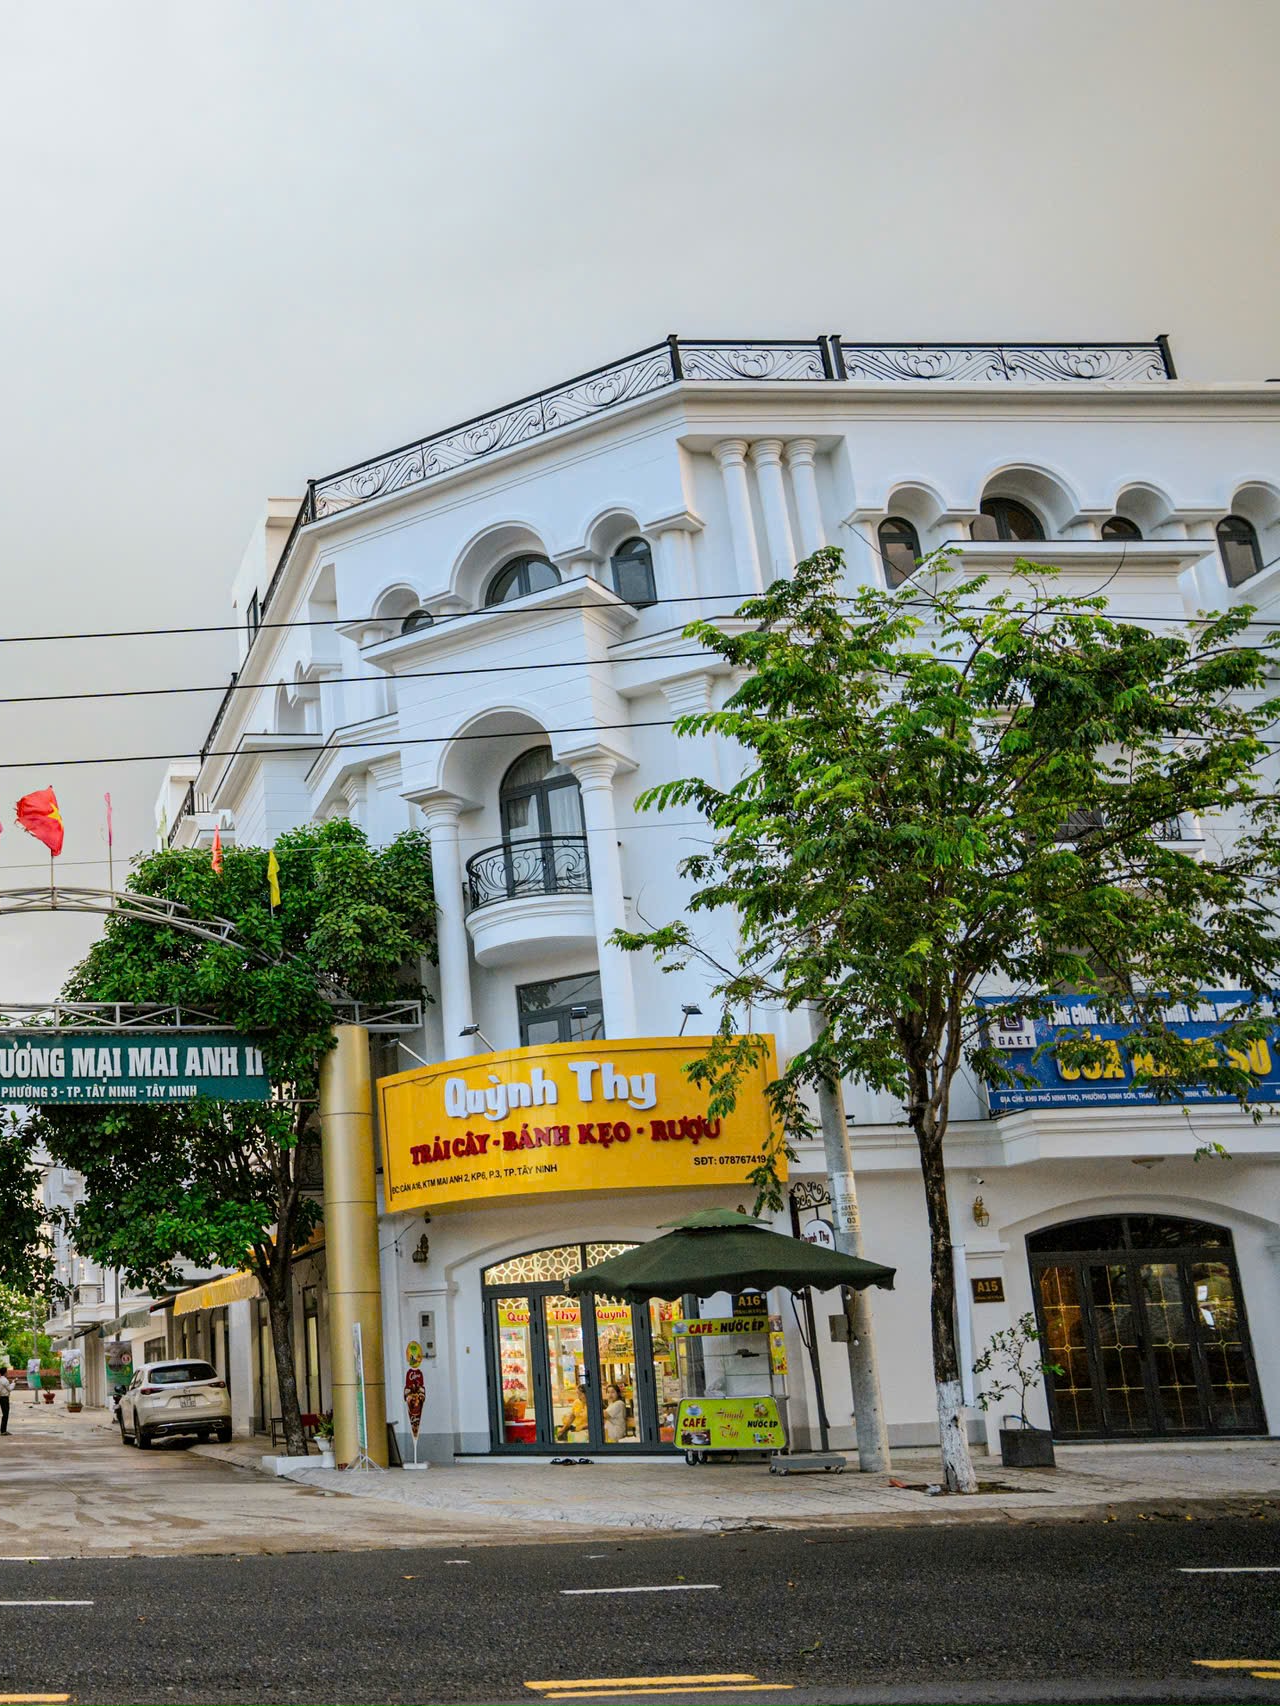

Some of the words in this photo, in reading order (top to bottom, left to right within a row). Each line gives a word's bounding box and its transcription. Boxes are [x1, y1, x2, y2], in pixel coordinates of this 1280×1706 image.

[998, 1036, 1031, 1045] GAET
[72, 1047, 122, 1083] MẠI
[128, 1047, 178, 1077] MAI
[185, 1046, 239, 1077] ANH
[245, 1046, 264, 1076] II
[1, 1083, 47, 1098] PHƯỜNG
[51, 1086, 58, 1098] 3
[66, 1086, 83, 1098] TP.
[85, 1083, 105, 1097] TÂY
[108, 1086, 136, 1097] NINH
[145, 1083, 165, 1097] TÂY
[169, 1085, 197, 1097] NINH
[444, 1067, 558, 1121] Quỳnh
[568, 1061, 657, 1110] Thy
[410, 1135, 451, 1166] TRÁI
[452, 1131, 490, 1158] CÂY
[502, 1123, 571, 1151] BÁNH
[577, 1121, 631, 1148] KẸO
[650, 1115, 720, 1144] RƯỢU
[693, 1156, 717, 1166] SĐT:
[718, 1154, 767, 1165] 078767419
[423, 1178, 436, 1188] KTM
[436, 1176, 448, 1186] MAI
[449, 1174, 463, 1184] ANH
[471, 1171, 488, 1181] KP6,
[488, 1170, 502, 1179] P.3,
[518, 1165, 533, 1176] TÂY
[535, 1163, 558, 1173] NINH
[818, 1230, 830, 1244] Thy
[977, 1280, 998, 1292] A15
[738, 1295, 760, 1306] A16
[553, 1310, 577, 1321] Thy
[688, 1321, 713, 1334] CAFÉ
[720, 1320, 751, 1333] NƯỚC
[752, 1319, 764, 1331] ÉP
[683, 1416, 707, 1427] CAFÉ
[747, 1419, 768, 1428] NƯỚC
[769, 1419, 778, 1428] ÉP
